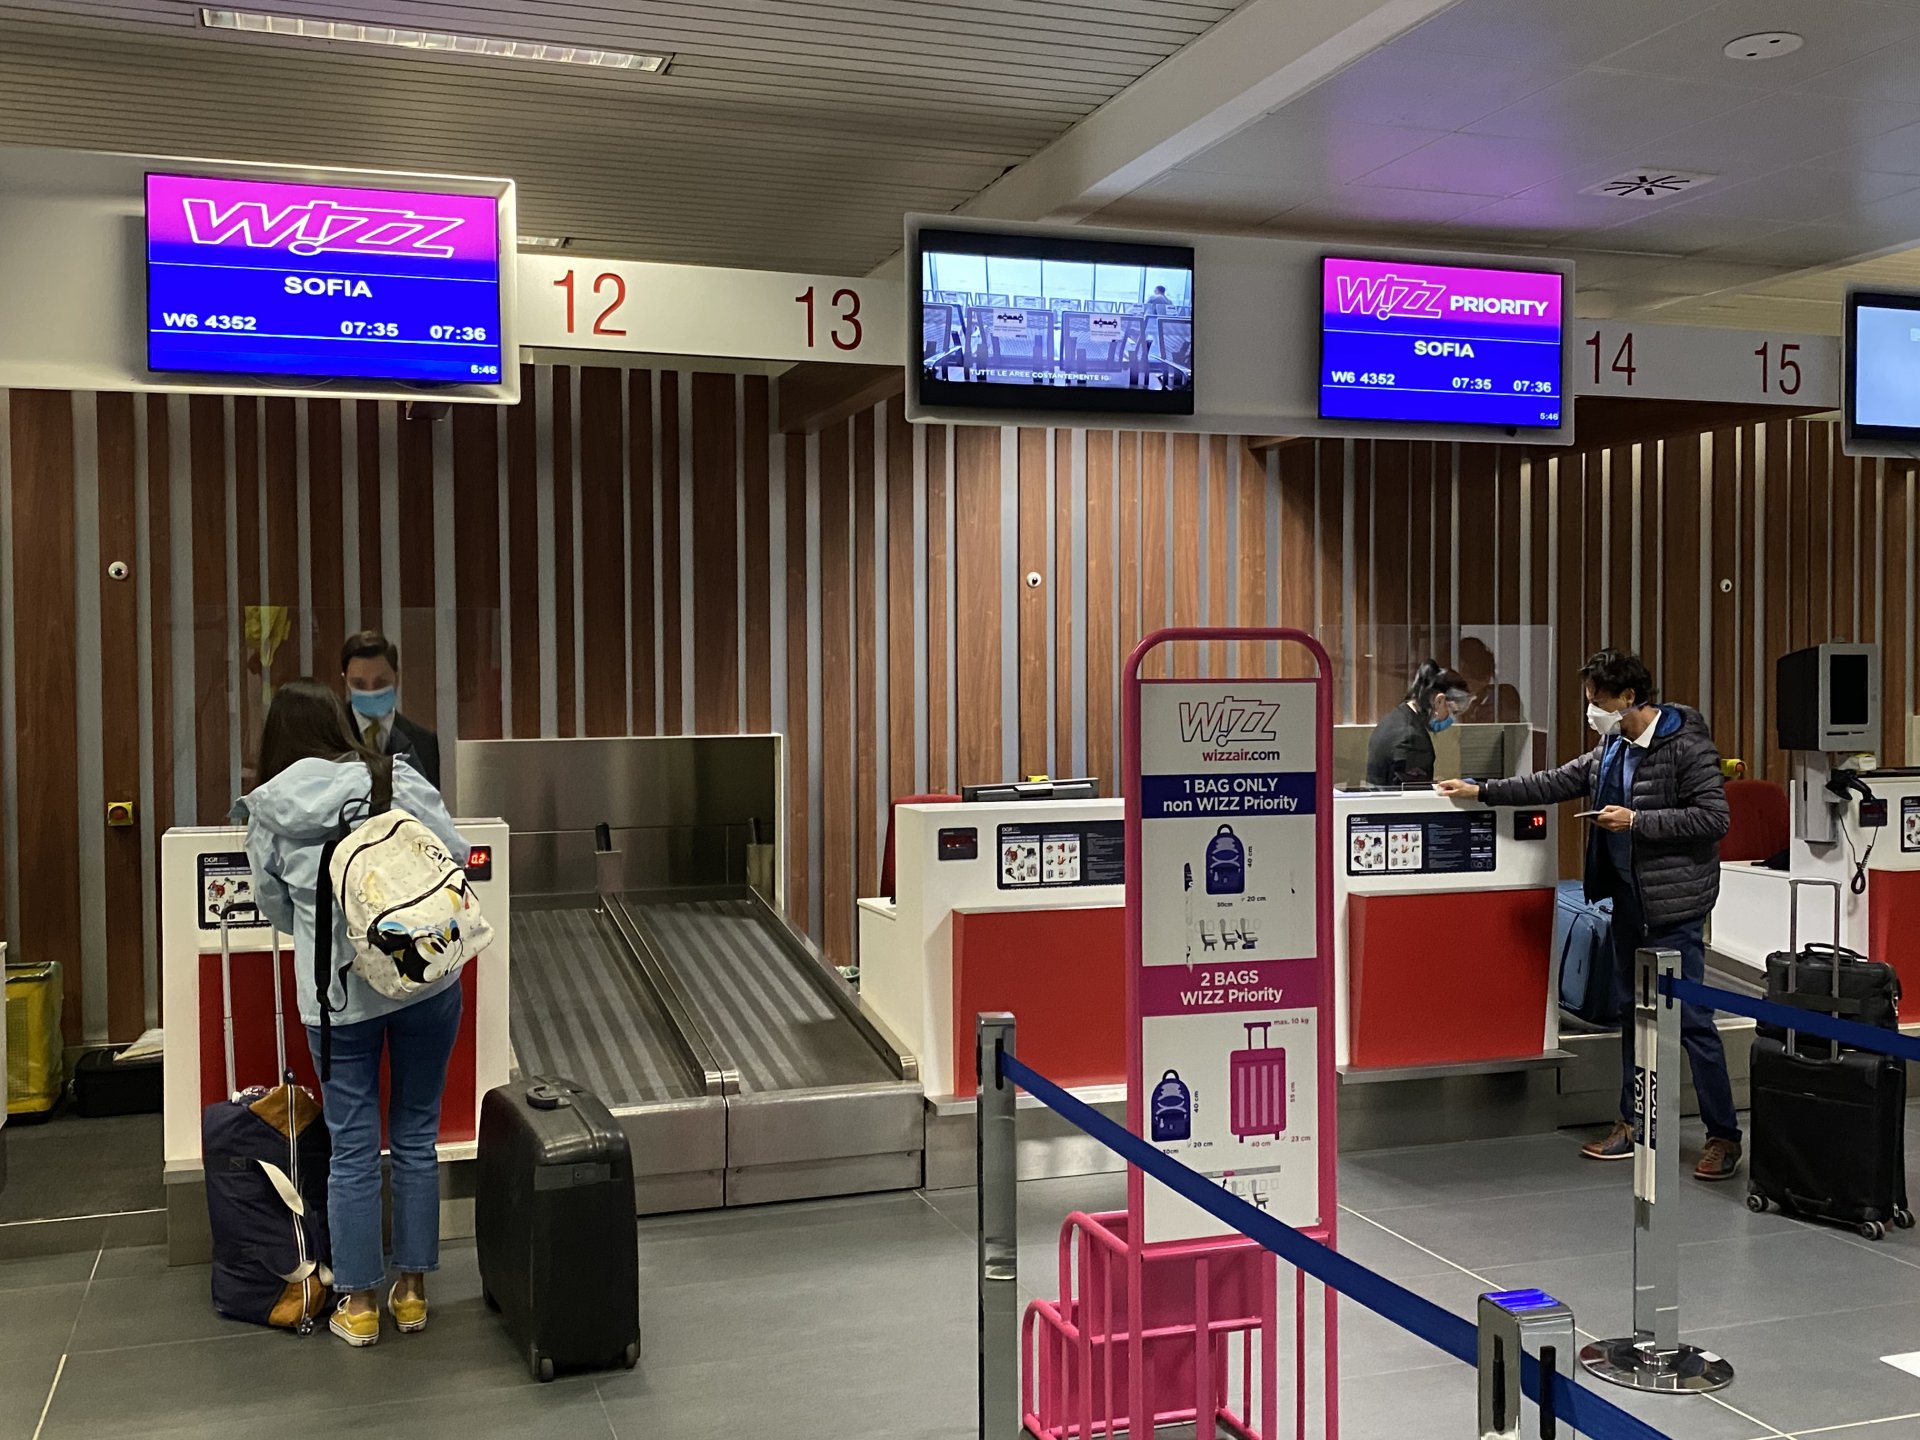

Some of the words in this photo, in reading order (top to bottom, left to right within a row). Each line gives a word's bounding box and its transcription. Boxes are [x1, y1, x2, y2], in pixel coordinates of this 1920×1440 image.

[182, 196, 465, 258] WIZZ
[284, 275, 373, 299] SOFIA
[1336, 274, 1447, 321] WIZZ
[1449, 295, 1549, 318] PRIORITY
[553, 269, 627, 337] 12
[163, 311, 198, 328] W6
[204, 312, 257, 331] 4352
[340, 320, 399, 338] 07:35
[430, 323, 487, 341] 07:36
[795, 285, 864, 351] 13
[1413, 340, 1475, 359] SOFIA
[1585, 331, 1637, 387] 14
[470, 363, 498, 376] 5:46
[1754, 341, 1802, 396] 15
[1331, 370, 1356, 385] W6
[1359, 371, 1396, 387] 4352
[1452, 375, 1493, 391] 07:35
[1513, 378, 1552, 394] 07:36
[1539, 411, 1559, 421] 5:46
[1179, 696, 1281, 748] WIZZ
[1202, 748, 1281, 761] wizzair.com
[1183, 780, 1190, 794] 1
[1195, 778, 1230, 793] BAG
[1234, 777, 1278, 792] ONLY
[1163, 799, 1192, 812] non
[1196, 796, 1240, 812] WIZZ
[1244, 794, 1298, 813] Priority
[1201, 973, 1210, 986] 2
[1214, 970, 1259, 985] BAGS
[1180, 990, 1224, 1006] WIZZ
[1228, 986, 1283, 1004] Priority
[1194, 1091, 1199, 1101] cm
[1194, 1103, 1199, 1113] 40
